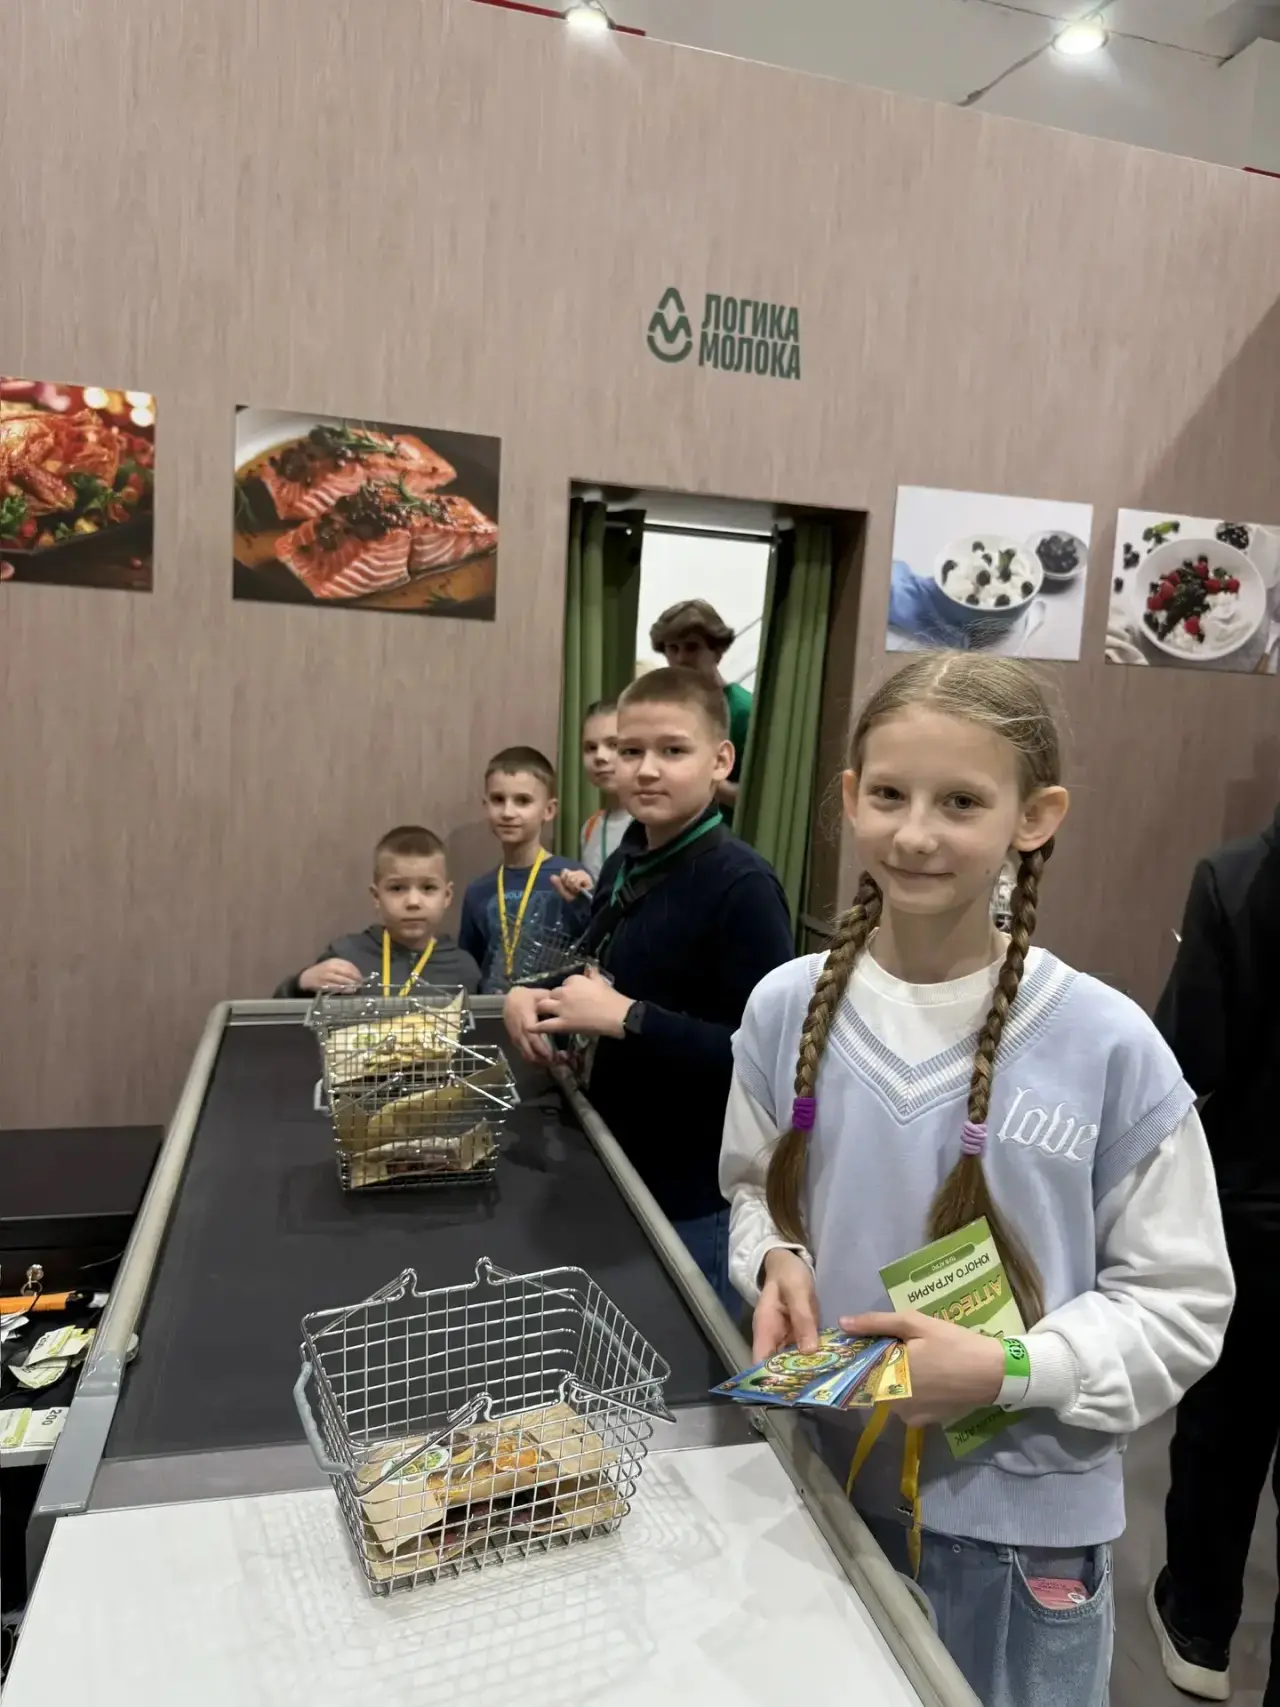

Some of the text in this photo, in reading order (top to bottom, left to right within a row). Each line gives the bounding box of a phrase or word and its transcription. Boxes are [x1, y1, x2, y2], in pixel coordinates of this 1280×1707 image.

[702, 294, 799, 343] ЛОГИКА
[698, 331, 801, 380] МОЛОКА
[907, 1253, 990, 1303] ЮНОГО АГРАРИЯ
[932, 1274, 1002, 1323] АТТЕСТ
[41, 1409, 62, 1426] 200
[954, 1426, 975, 1447] АПК
